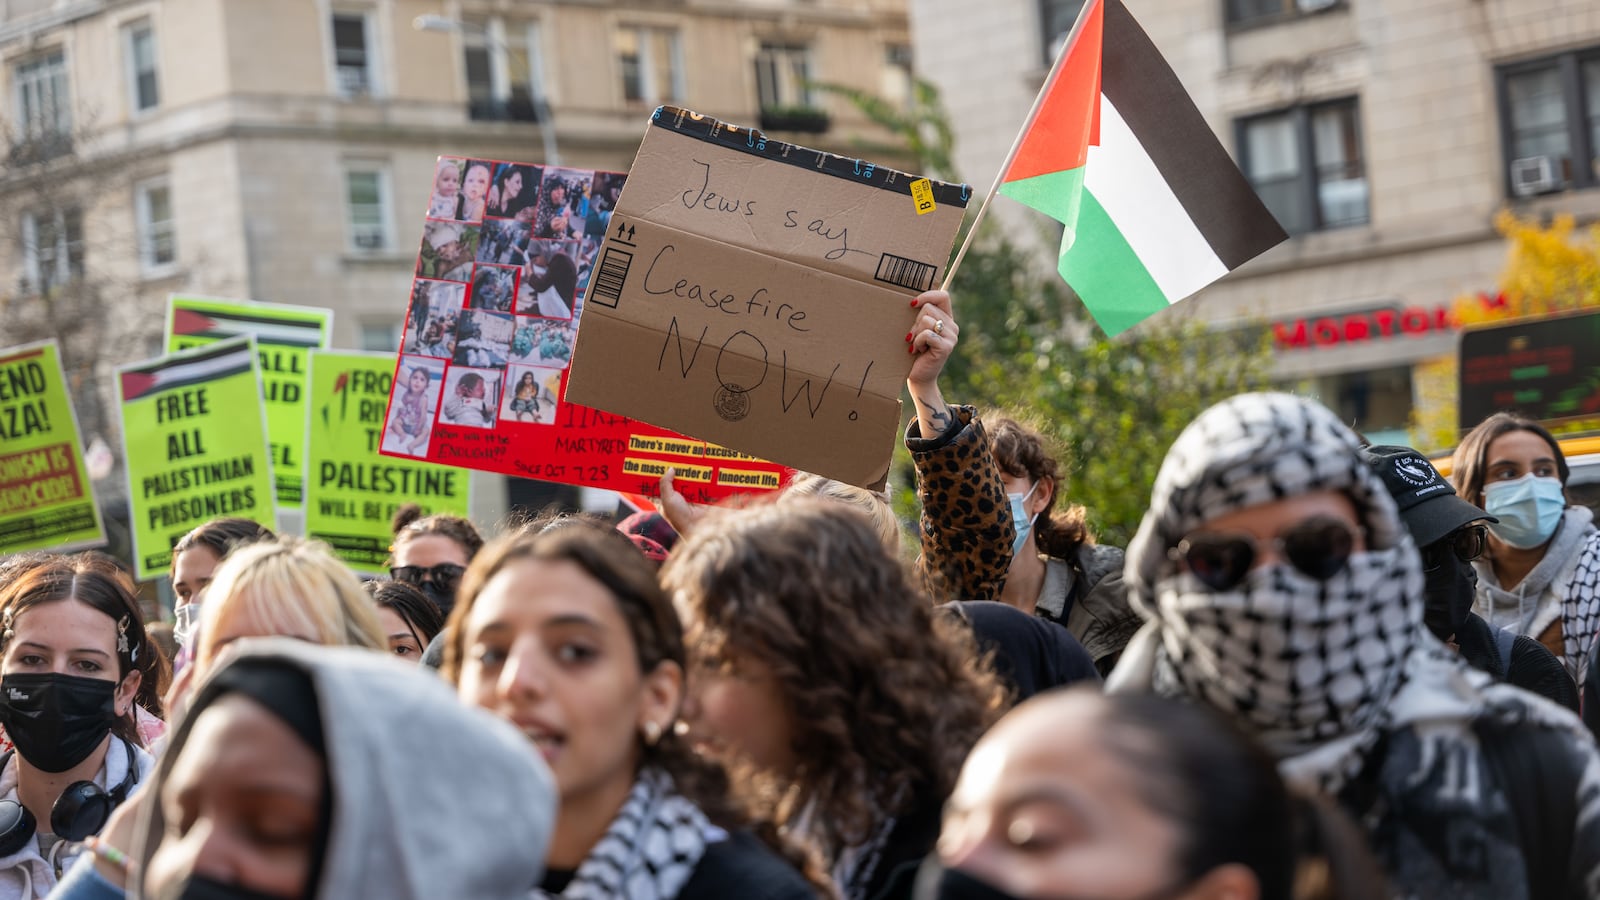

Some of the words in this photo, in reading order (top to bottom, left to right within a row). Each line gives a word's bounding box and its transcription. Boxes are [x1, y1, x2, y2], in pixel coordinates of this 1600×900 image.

[682, 159, 756, 217] Jews
[784, 210, 877, 259] say
[919, 200, 932, 211] B
[351, 369, 392, 395] FRO
[658, 316, 874, 422] NOW!
[263, 381, 300, 402] ID
[156, 388, 209, 425] FREE
[168, 428, 206, 462] ALL
[554, 436, 626, 455] MARTYRED
[630, 437, 663, 451] There's
[665, 441, 690, 455] never
[692, 445, 705, 456] an
[705, 446, 738, 458] excuse
[142, 454, 254, 499] PALESTINIAN
[320, 461, 456, 497] PALESTINE
[544, 464, 566, 477] OCT
[624, 460, 640, 472] the
[641, 463, 665, 475] mass
[668, 466, 702, 480] urder
[702, 470, 713, 480] of
[148, 486, 256, 531] PRISONERS
[319, 499, 356, 519] WILL
[363, 501, 381, 522] BE
